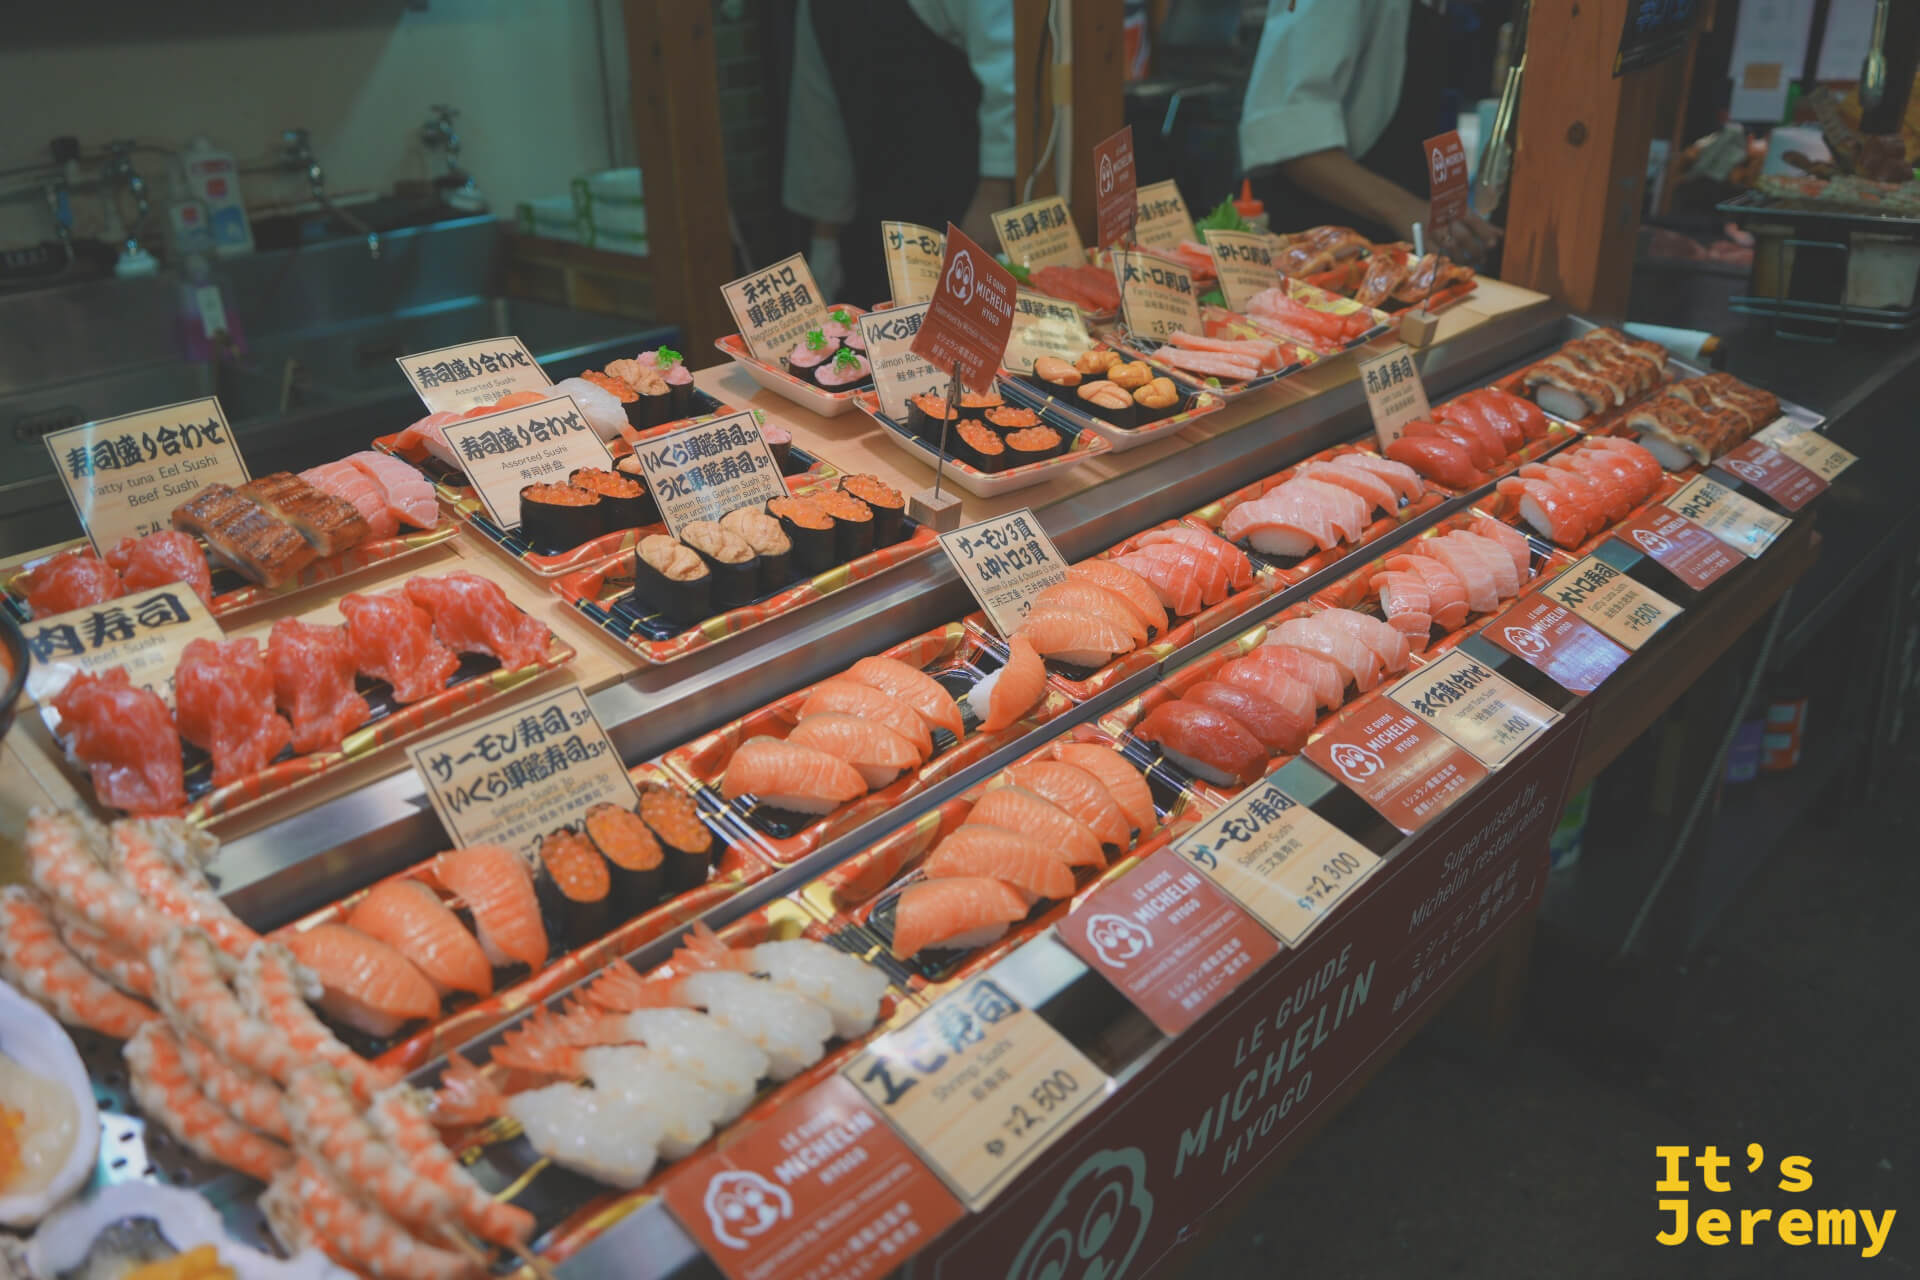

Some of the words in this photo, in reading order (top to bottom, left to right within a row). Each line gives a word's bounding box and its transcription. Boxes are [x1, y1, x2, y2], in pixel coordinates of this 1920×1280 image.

[975, 281, 1012, 318] MICHELIN
[416, 349, 532, 389] 寿司盛り合わせ
[66, 417, 226, 479] 寿司盛り合わせ
[459, 410, 586, 462] 寿司盛り合わせ
[501, 454, 543, 471] Assorted
[545, 445, 568, 459] Sushi
[127, 475, 155, 487] tuna
[158, 464, 181, 479] Eel
[182, 455, 219, 473] Sushi
[128, 489, 160, 507] Beef
[163, 478, 200, 497] Sushi
[1556, 562, 1621, 609] 大トロ寿司
[26, 592, 191, 665] 肉寿司
[1533, 606, 1569, 636] MICHELIN
[1363, 725, 1373, 736] LE
[1372, 713, 1395, 730] GUIDE
[1365, 715, 1418, 752] MICHELIN
[1188, 787, 1297, 871] サーモン寿司
[1269, 822, 1294, 844] Sushi
[1440, 791, 1521, 879] Supervised
[1520, 780, 1538, 809] by
[1408, 867, 1469, 934] Michelin
[1472, 796, 1547, 876] restaurants
[1133, 871, 1202, 925] MICHELIN
[1233, 1017, 1268, 1069] LE
[1275, 942, 1353, 1030] GUIDE
[1173, 959, 1376, 1180] MICHELIN
[774, 1110, 876, 1185] MICHELIN
[1221, 1070, 1312, 1176] HYOGO
